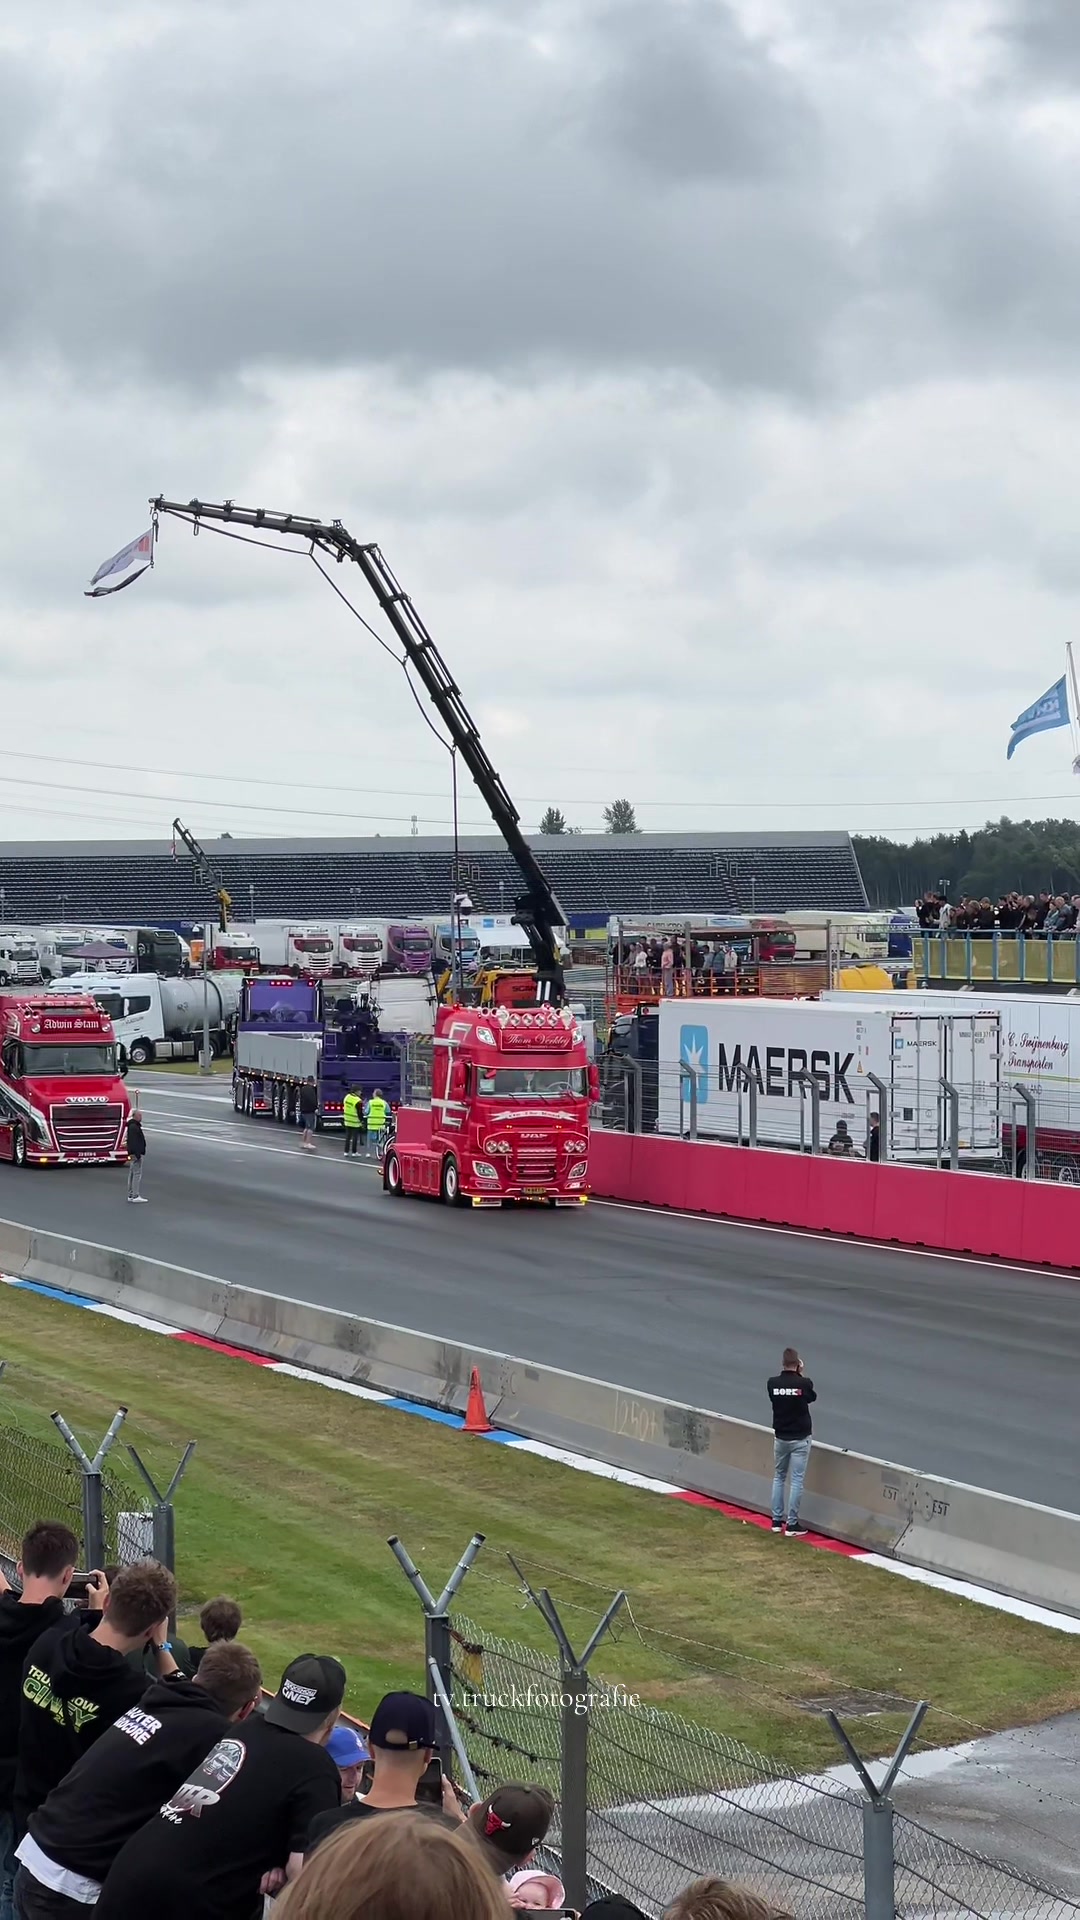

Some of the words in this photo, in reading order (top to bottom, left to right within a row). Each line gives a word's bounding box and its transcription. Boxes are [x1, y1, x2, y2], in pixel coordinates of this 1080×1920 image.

[74, 1019, 99, 1029] Stam
[504, 1034, 532, 1045] Thom
[719, 1043, 854, 1103] MAERSK
